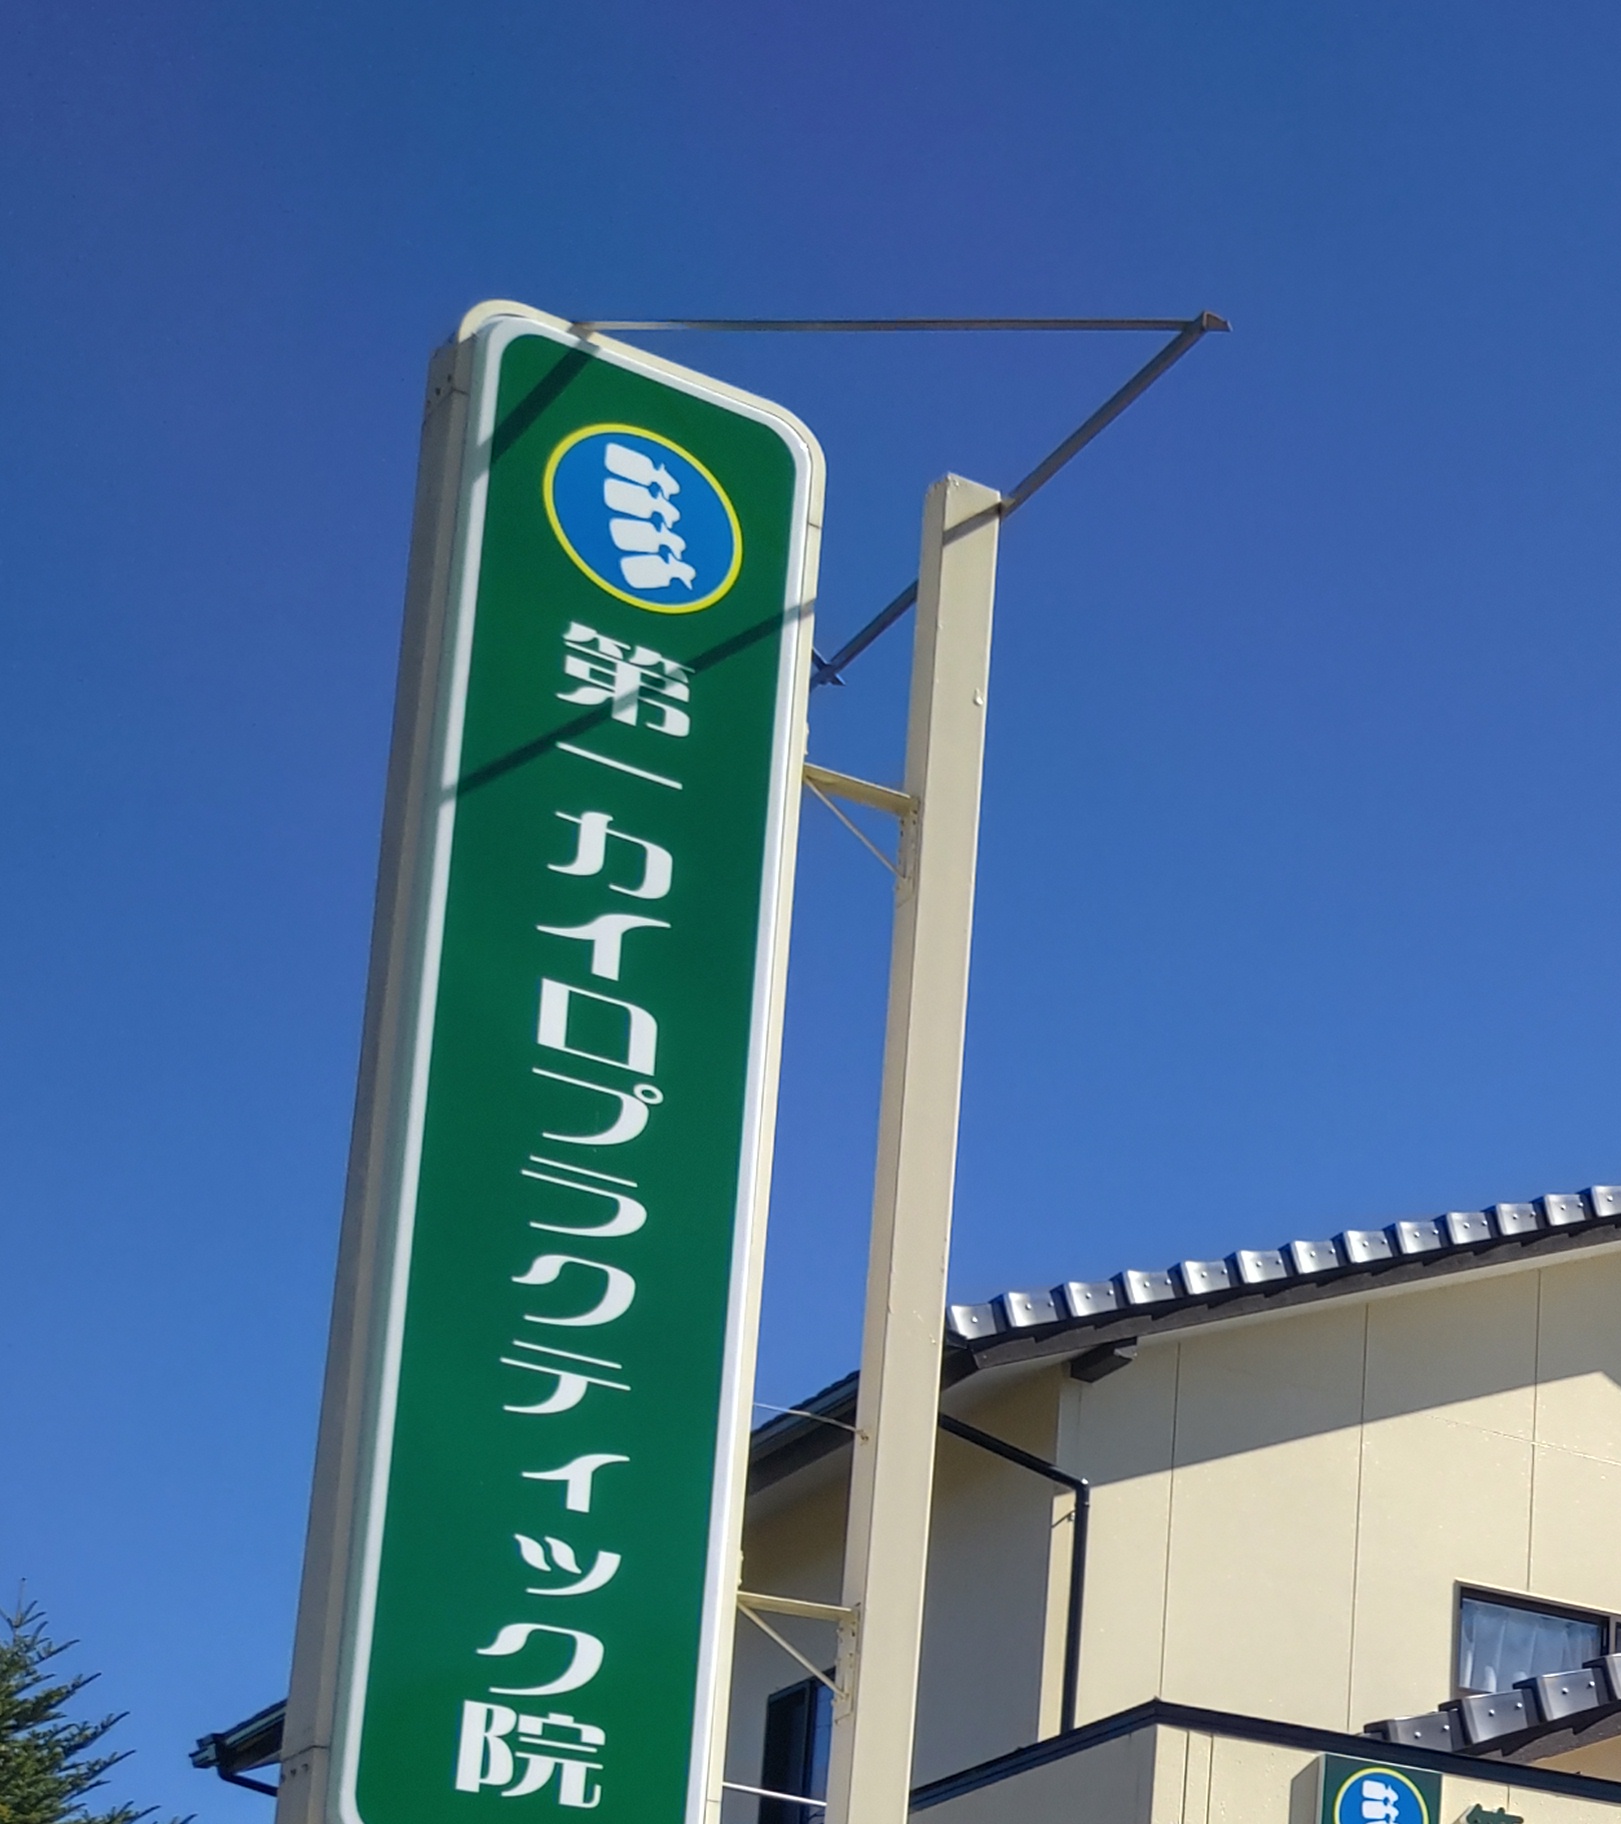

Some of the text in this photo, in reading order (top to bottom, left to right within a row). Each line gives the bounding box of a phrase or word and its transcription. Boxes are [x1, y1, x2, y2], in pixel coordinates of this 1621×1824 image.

[455, 619, 696, 1810] 第一カイロプラクティック院
